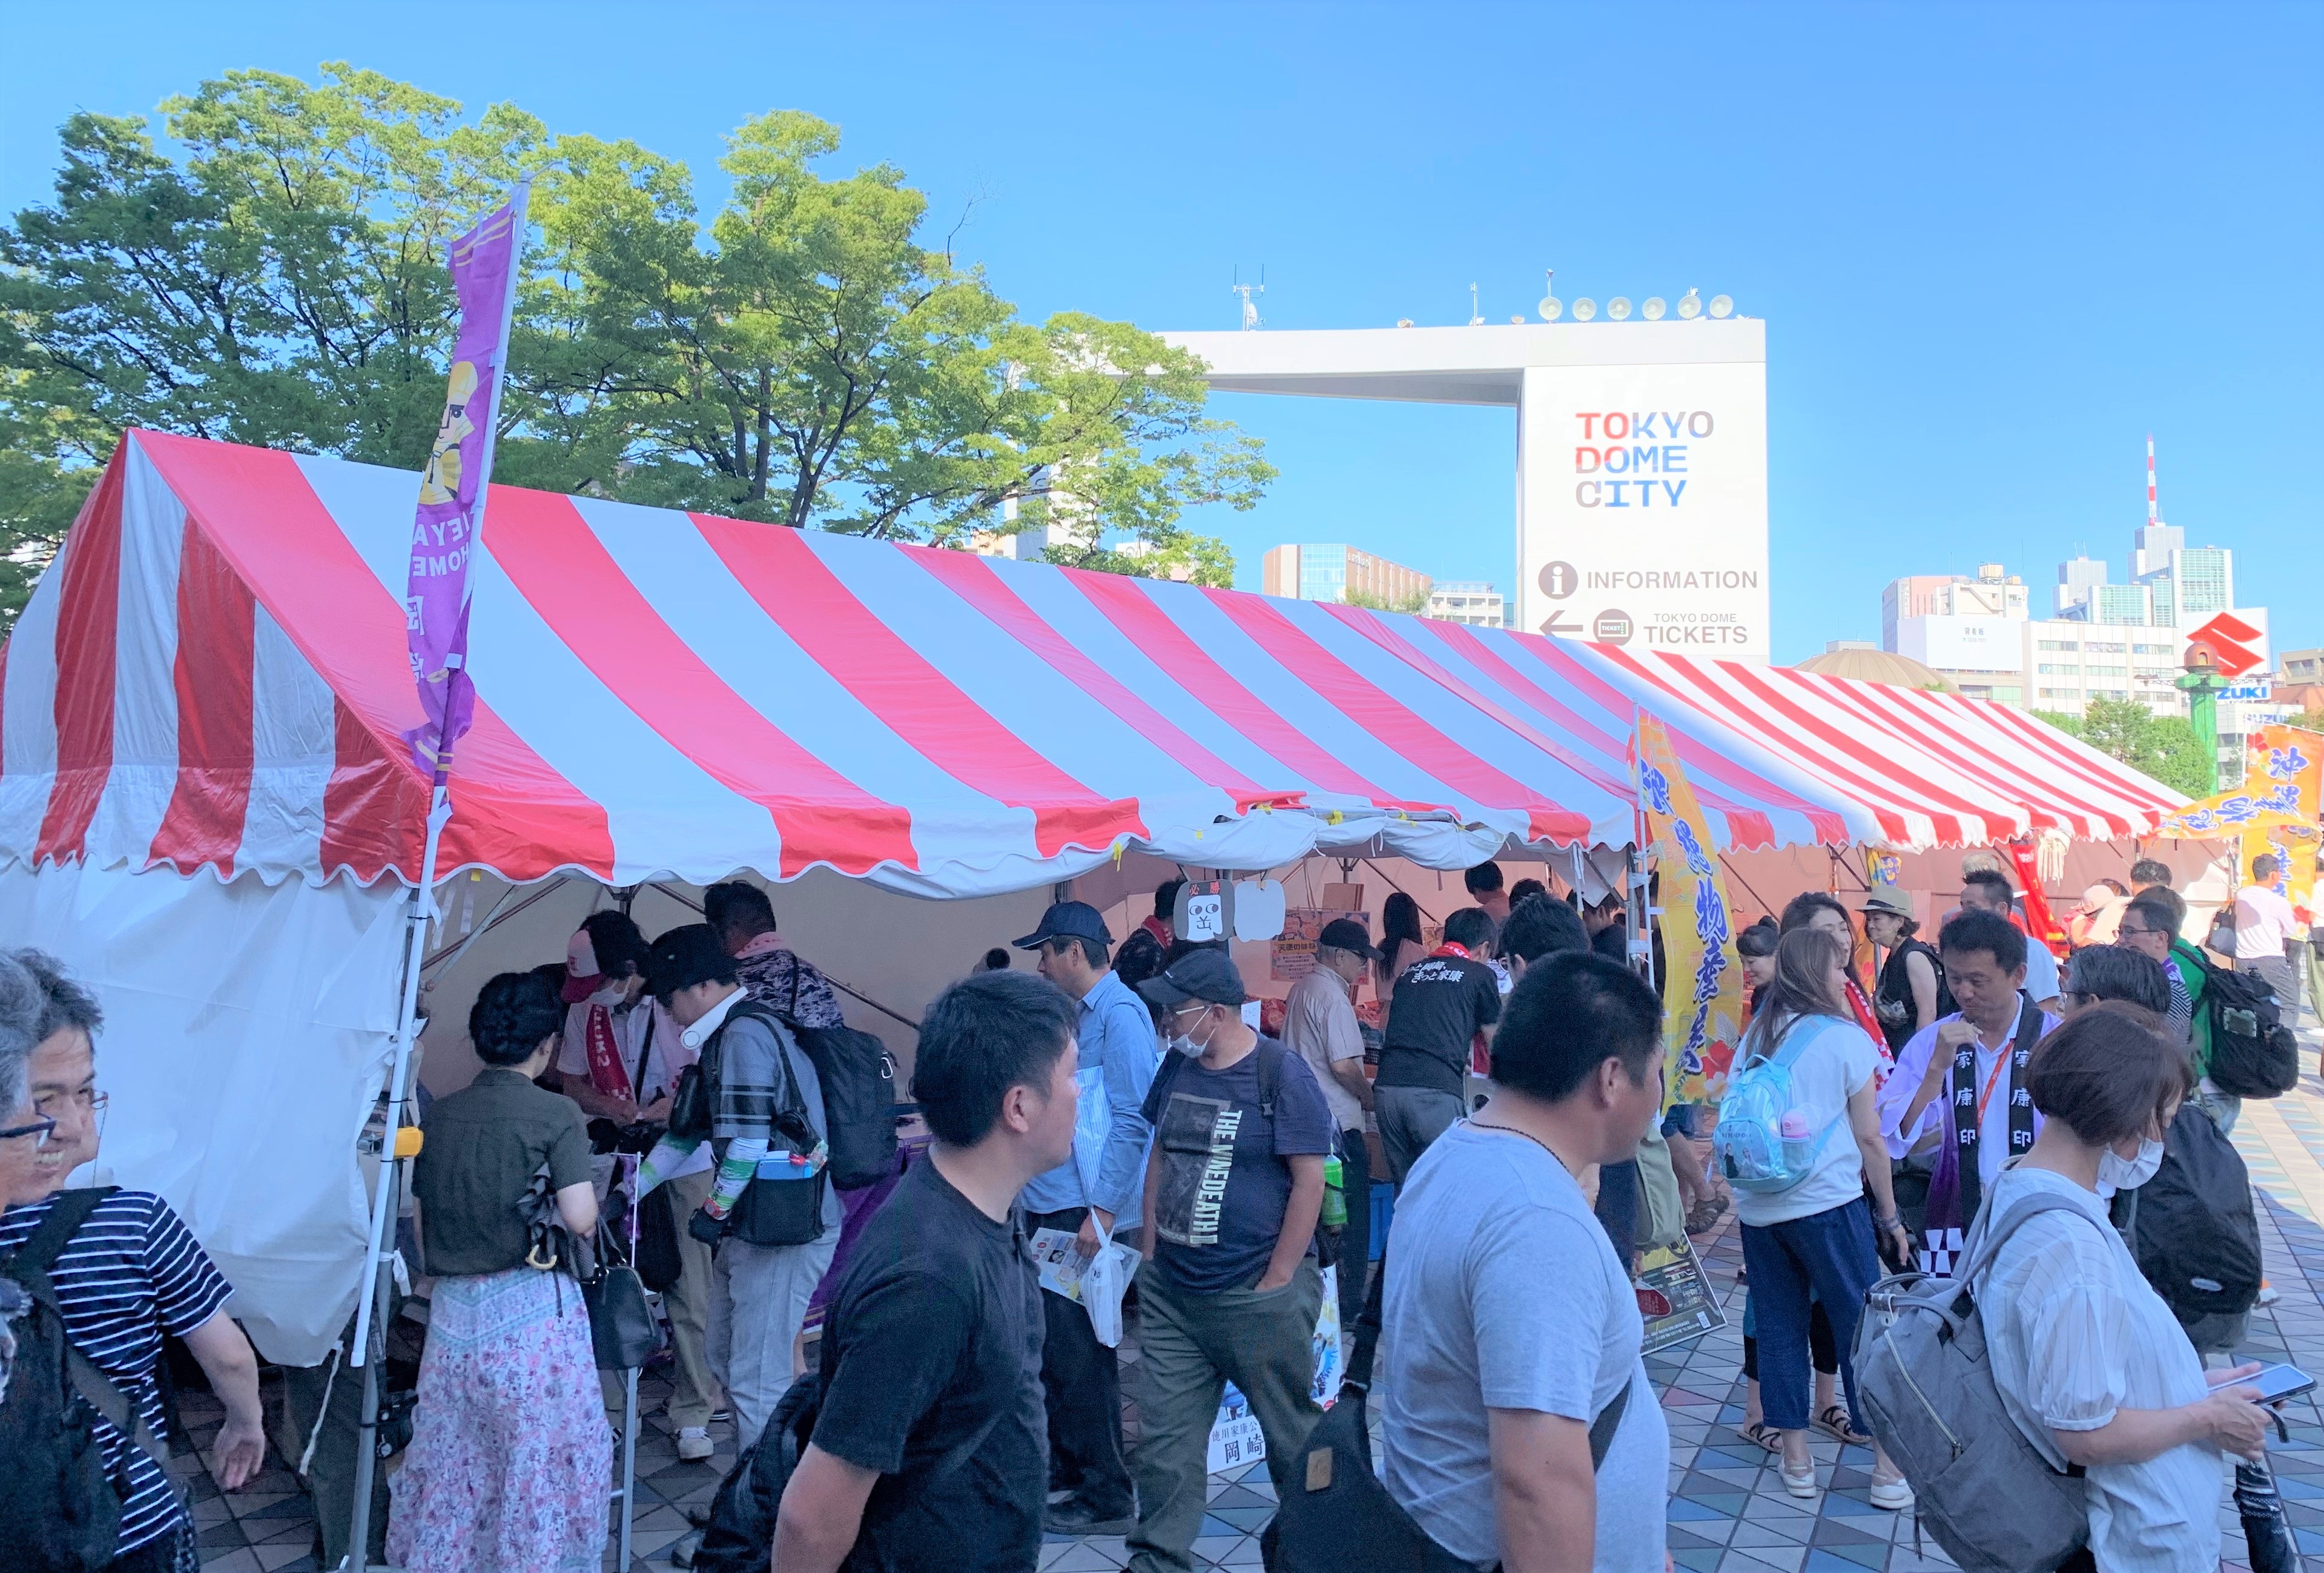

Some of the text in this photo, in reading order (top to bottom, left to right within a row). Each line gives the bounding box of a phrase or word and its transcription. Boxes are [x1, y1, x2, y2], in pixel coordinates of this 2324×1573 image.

[1576, 411, 1714, 440] TOKYO
[1576, 446, 1688, 473] DOME
[1576, 480, 1687, 507] CITY
[1588, 571, 1757, 589] INFORMATION
[1654, 613, 1737, 622] TOKYO DOME
[1643, 626, 1748, 644] TICKETS
[2216, 687, 2268, 701] ZUKI
[1956, 1051, 1975, 1145] 家康印
[1213, 1110, 1243, 1140] THE
[1212, 1420, 1261, 1442] 徳川家康公
[1224, 1433, 1264, 1463] 岡崎
